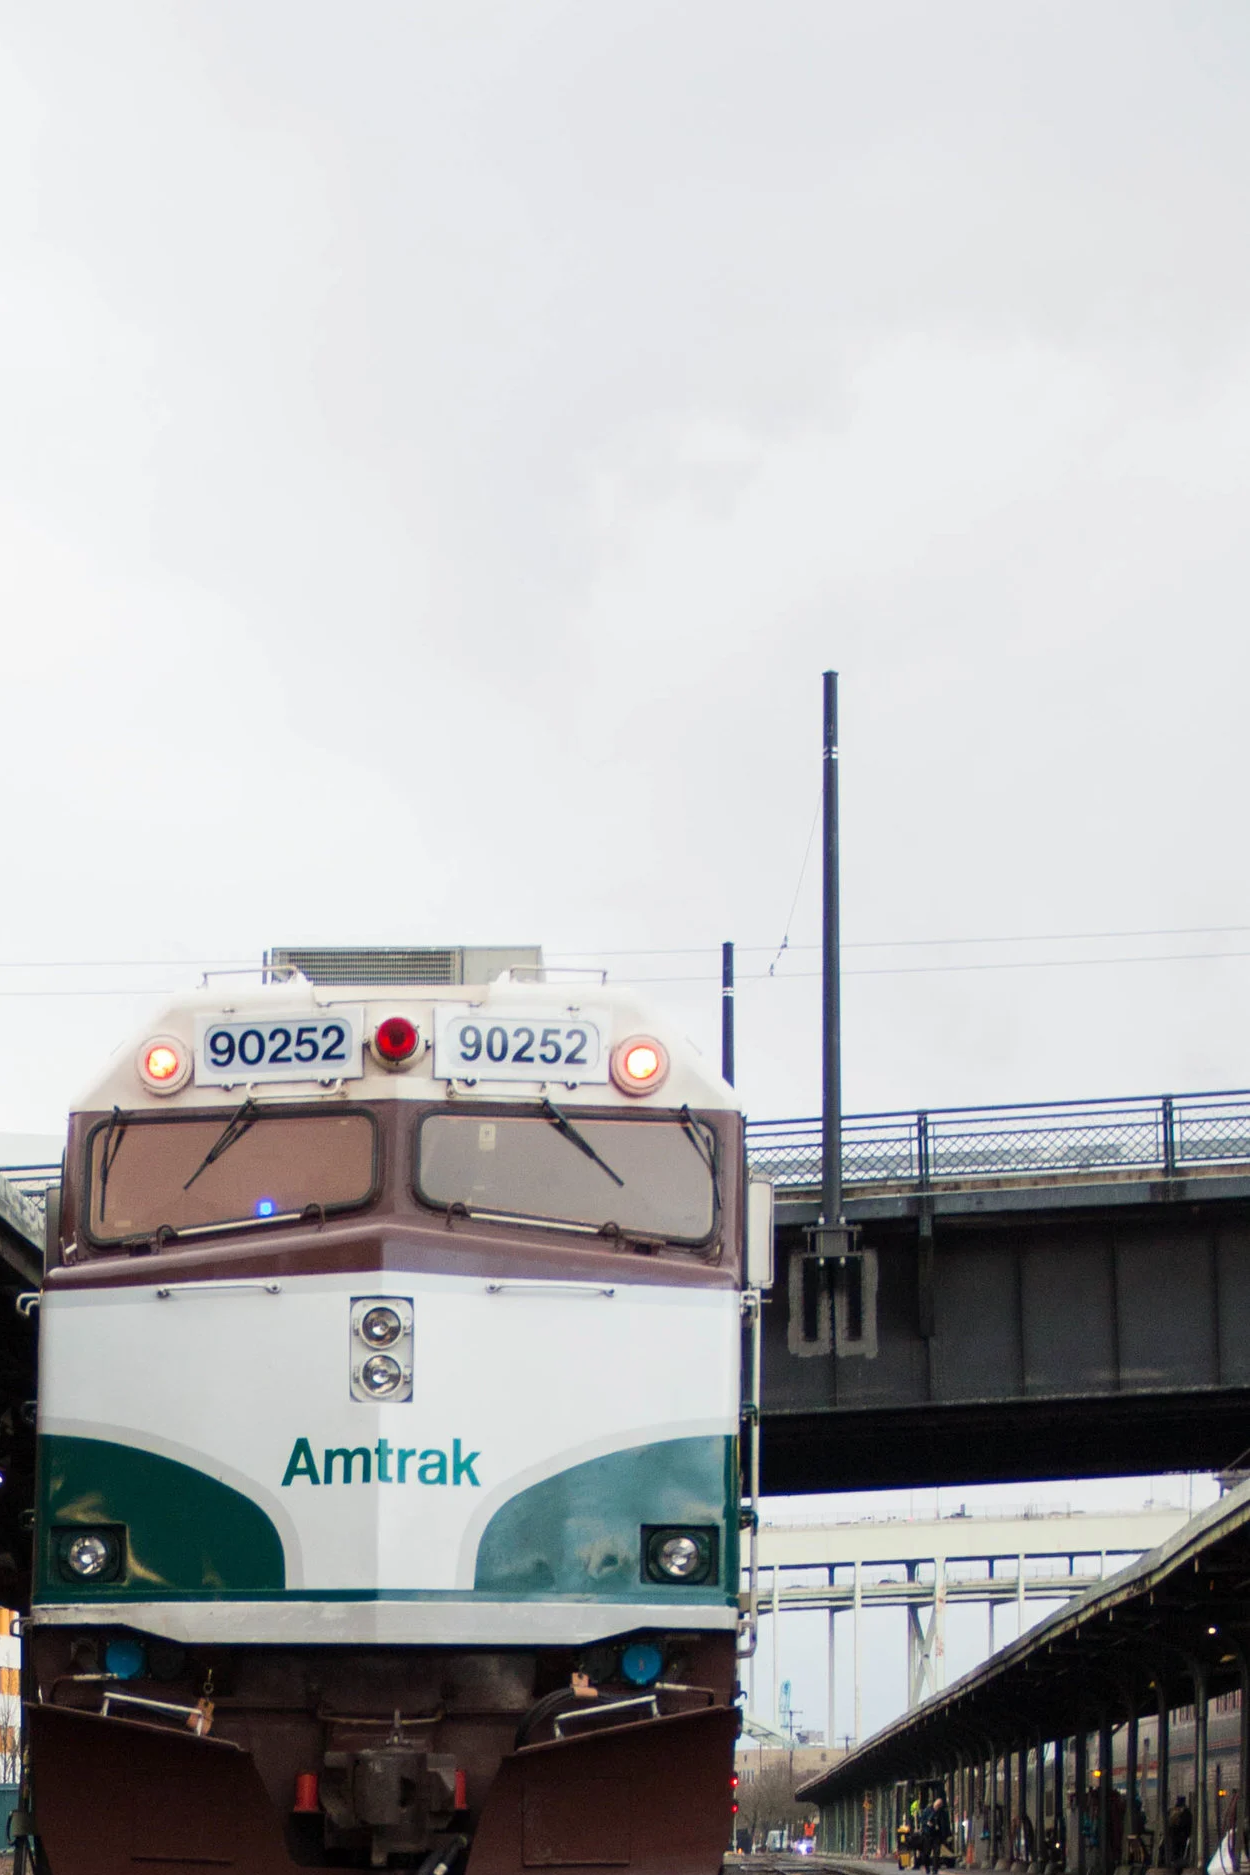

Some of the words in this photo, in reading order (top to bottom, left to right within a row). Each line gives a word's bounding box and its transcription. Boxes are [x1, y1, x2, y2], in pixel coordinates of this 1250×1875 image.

[209, 1024, 346, 1068] 90252
[459, 1025, 588, 1065] 90252
[281, 1437, 482, 1487] Amtrak
